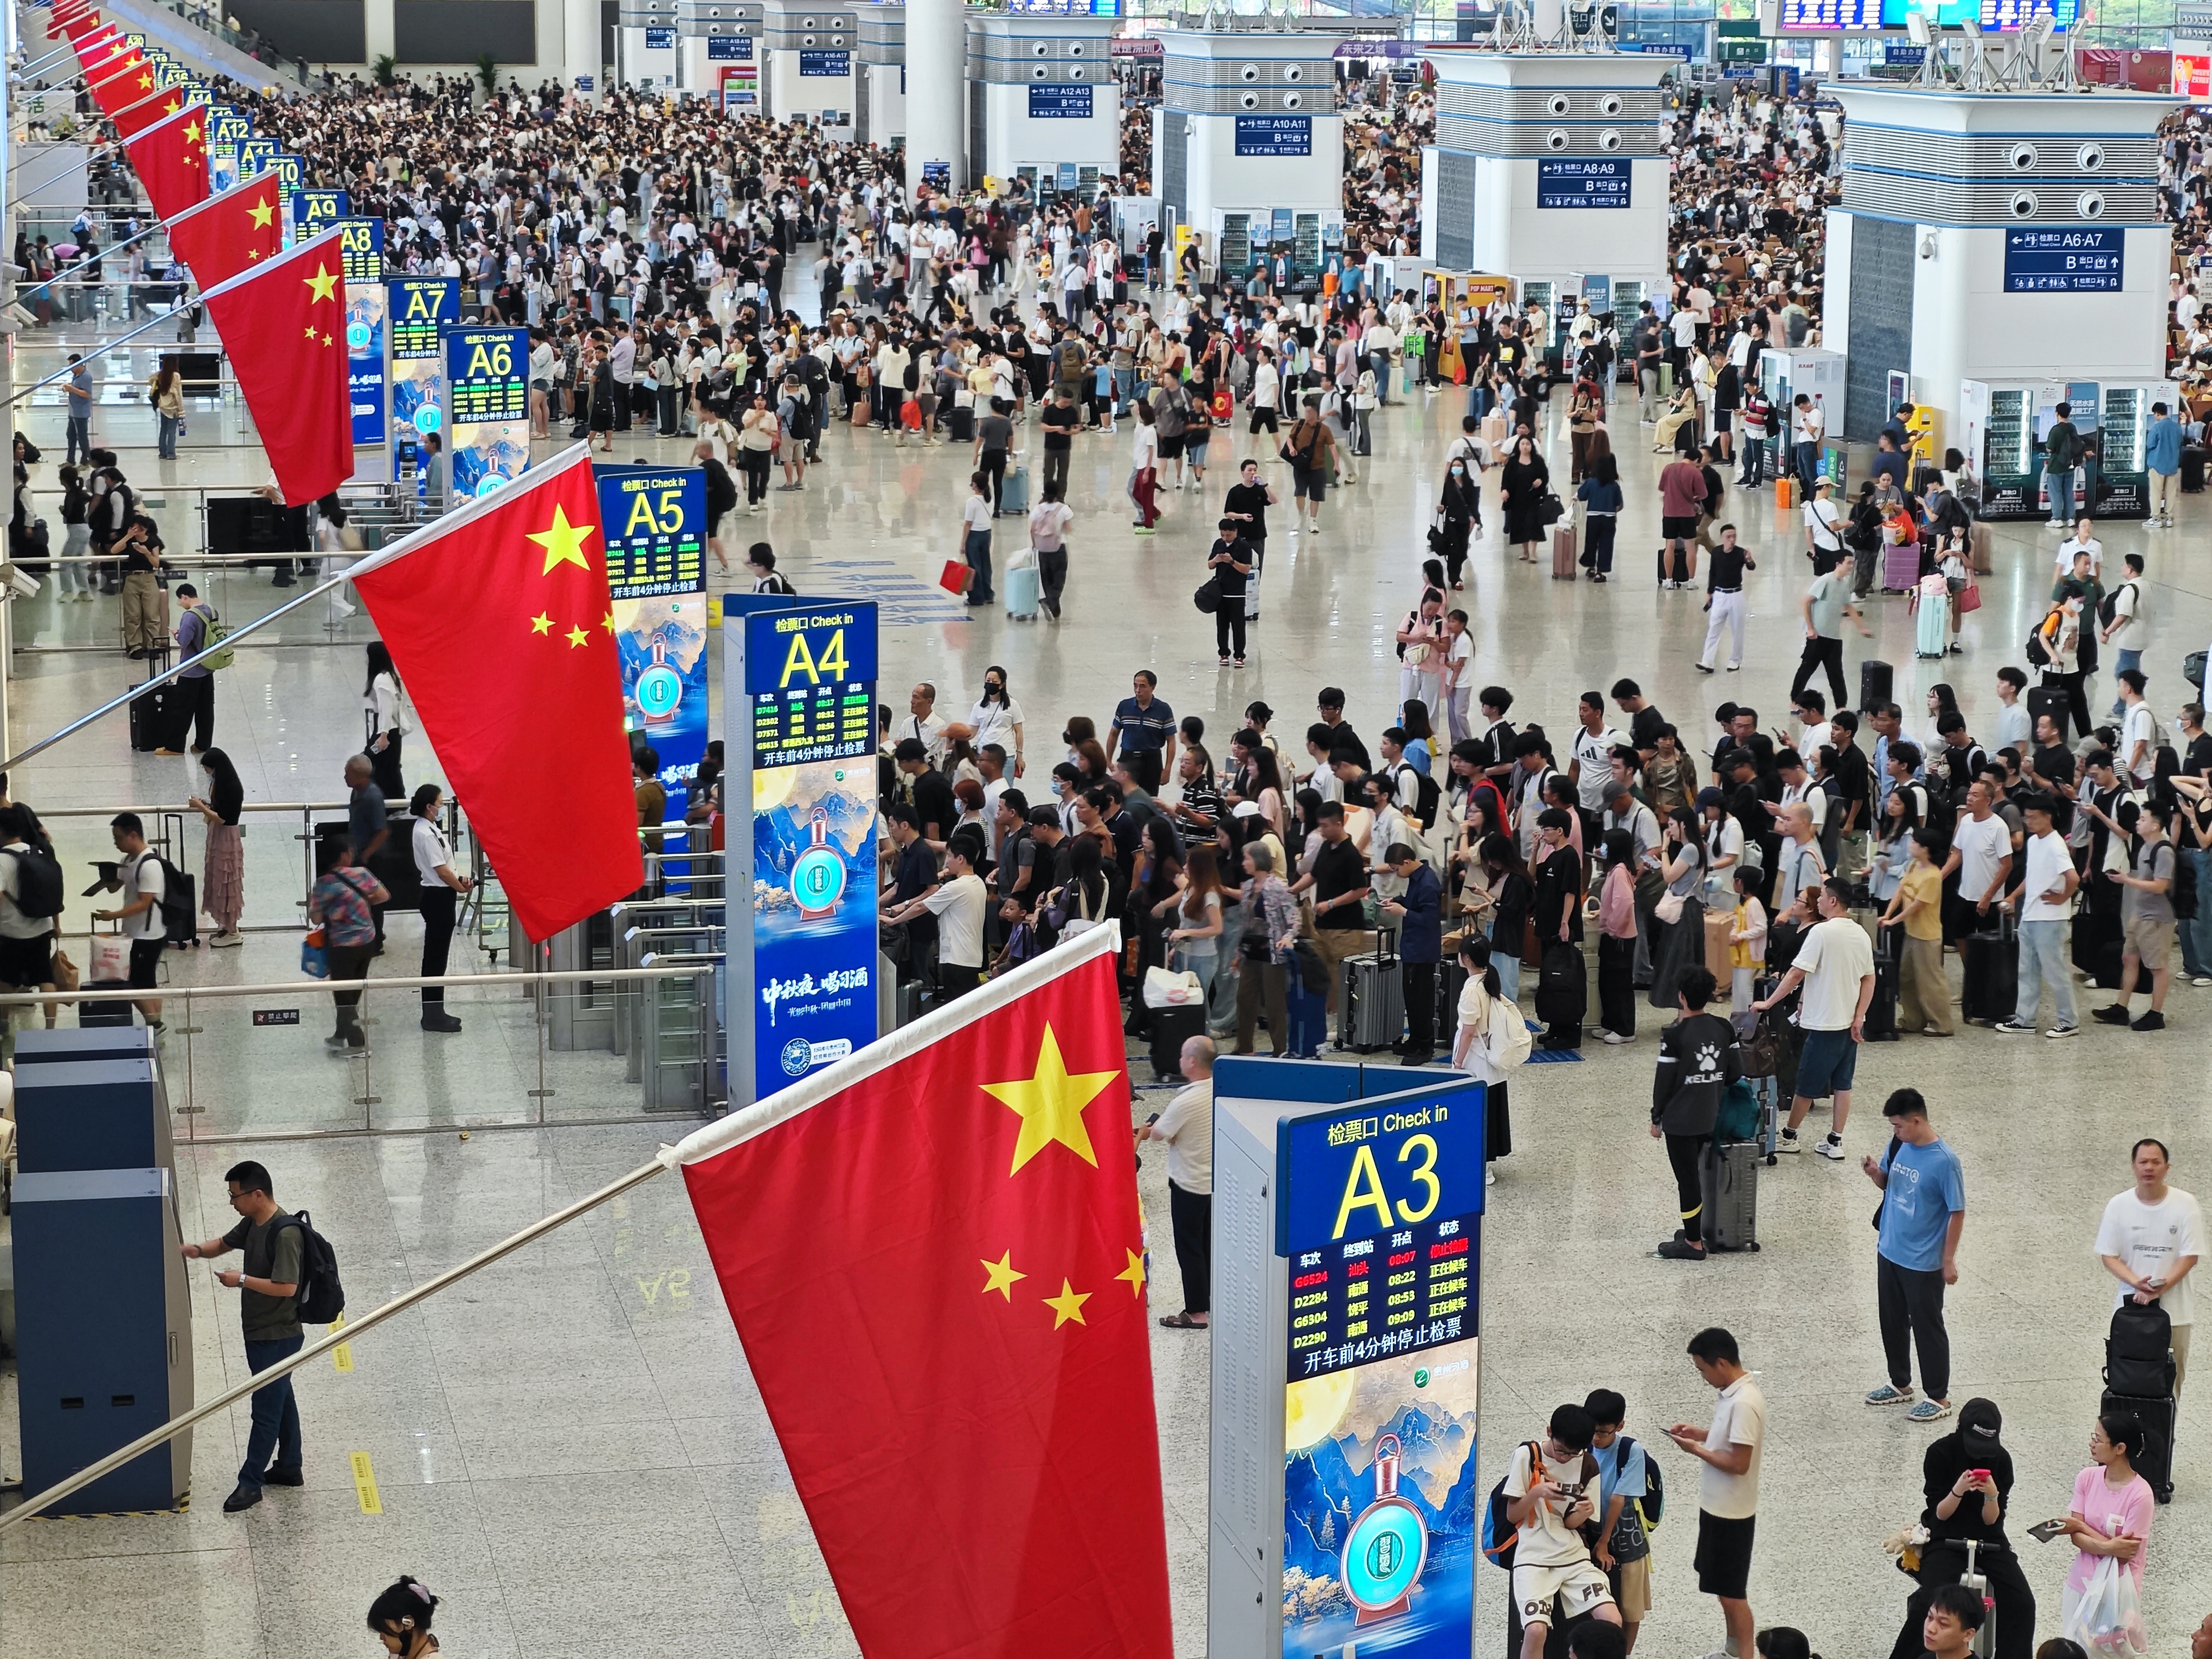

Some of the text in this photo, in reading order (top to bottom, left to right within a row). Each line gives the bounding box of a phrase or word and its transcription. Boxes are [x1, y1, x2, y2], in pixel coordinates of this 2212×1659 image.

[1342, 44, 1386, 54] 未来之城
[217, 123, 249, 138] A12
[1275, 133, 1282, 142] B
[1586, 181, 1594, 191] B
[306, 200, 337, 221] A9
[1591, 197, 1596, 205] 1
[340, 228, 372, 252] A8
[2040, 234, 2060, 242] 检票口
[2066, 256, 2076, 269] B
[2073, 278, 2078, 288] 1
[406, 290, 446, 319] A7
[465, 335, 486, 344] 检票口
[467, 343, 512, 377] A6
[622, 477, 686, 492] 检票口 Check in
[625, 490, 684, 536] A5
[657, 536, 670, 544] 开点
[613, 580, 697, 598] 开车前4分钟停止检票
[775, 613, 853, 633] 检票口 Check in
[779, 629, 850, 689] A4
[759, 683, 863, 703] 车次 终到站 开点 状态
[756, 705, 778, 715] D7416
[816, 699, 835, 708] 08:17
[843, 706, 869, 717] 正在候车
[756, 729, 779, 738] D7571
[843, 718, 869, 729] 正在候车
[756, 741, 779, 750] G5615
[816, 734, 835, 743] 09:17
[843, 729, 869, 741] 正在候车
[763, 741, 866, 766] 开车前4分钟停止检票
[762, 967, 868, 1027] 中秋夜 喝习酒
[1328, 1104, 1448, 1146] 检票口 Check in
[1332, 1133, 1441, 1240] A3
[1300, 1219, 1459, 1268] 车次 终到站 开点 状态
[1294, 1238, 1469, 1289] G6524 汕头 08:07 停止检票
[1294, 1257, 1468, 1309] D2284 南通 08:22 正在候车
[1294, 1277, 1468, 1329] G6304 饶平 08:53 正在候车
[1294, 1296, 1467, 1349] D2290 南通 09:09 正在候车
[1304, 1315, 1462, 1374] 开车前4分钟停止检票
[1582, 1582, 1612, 1602] FP
